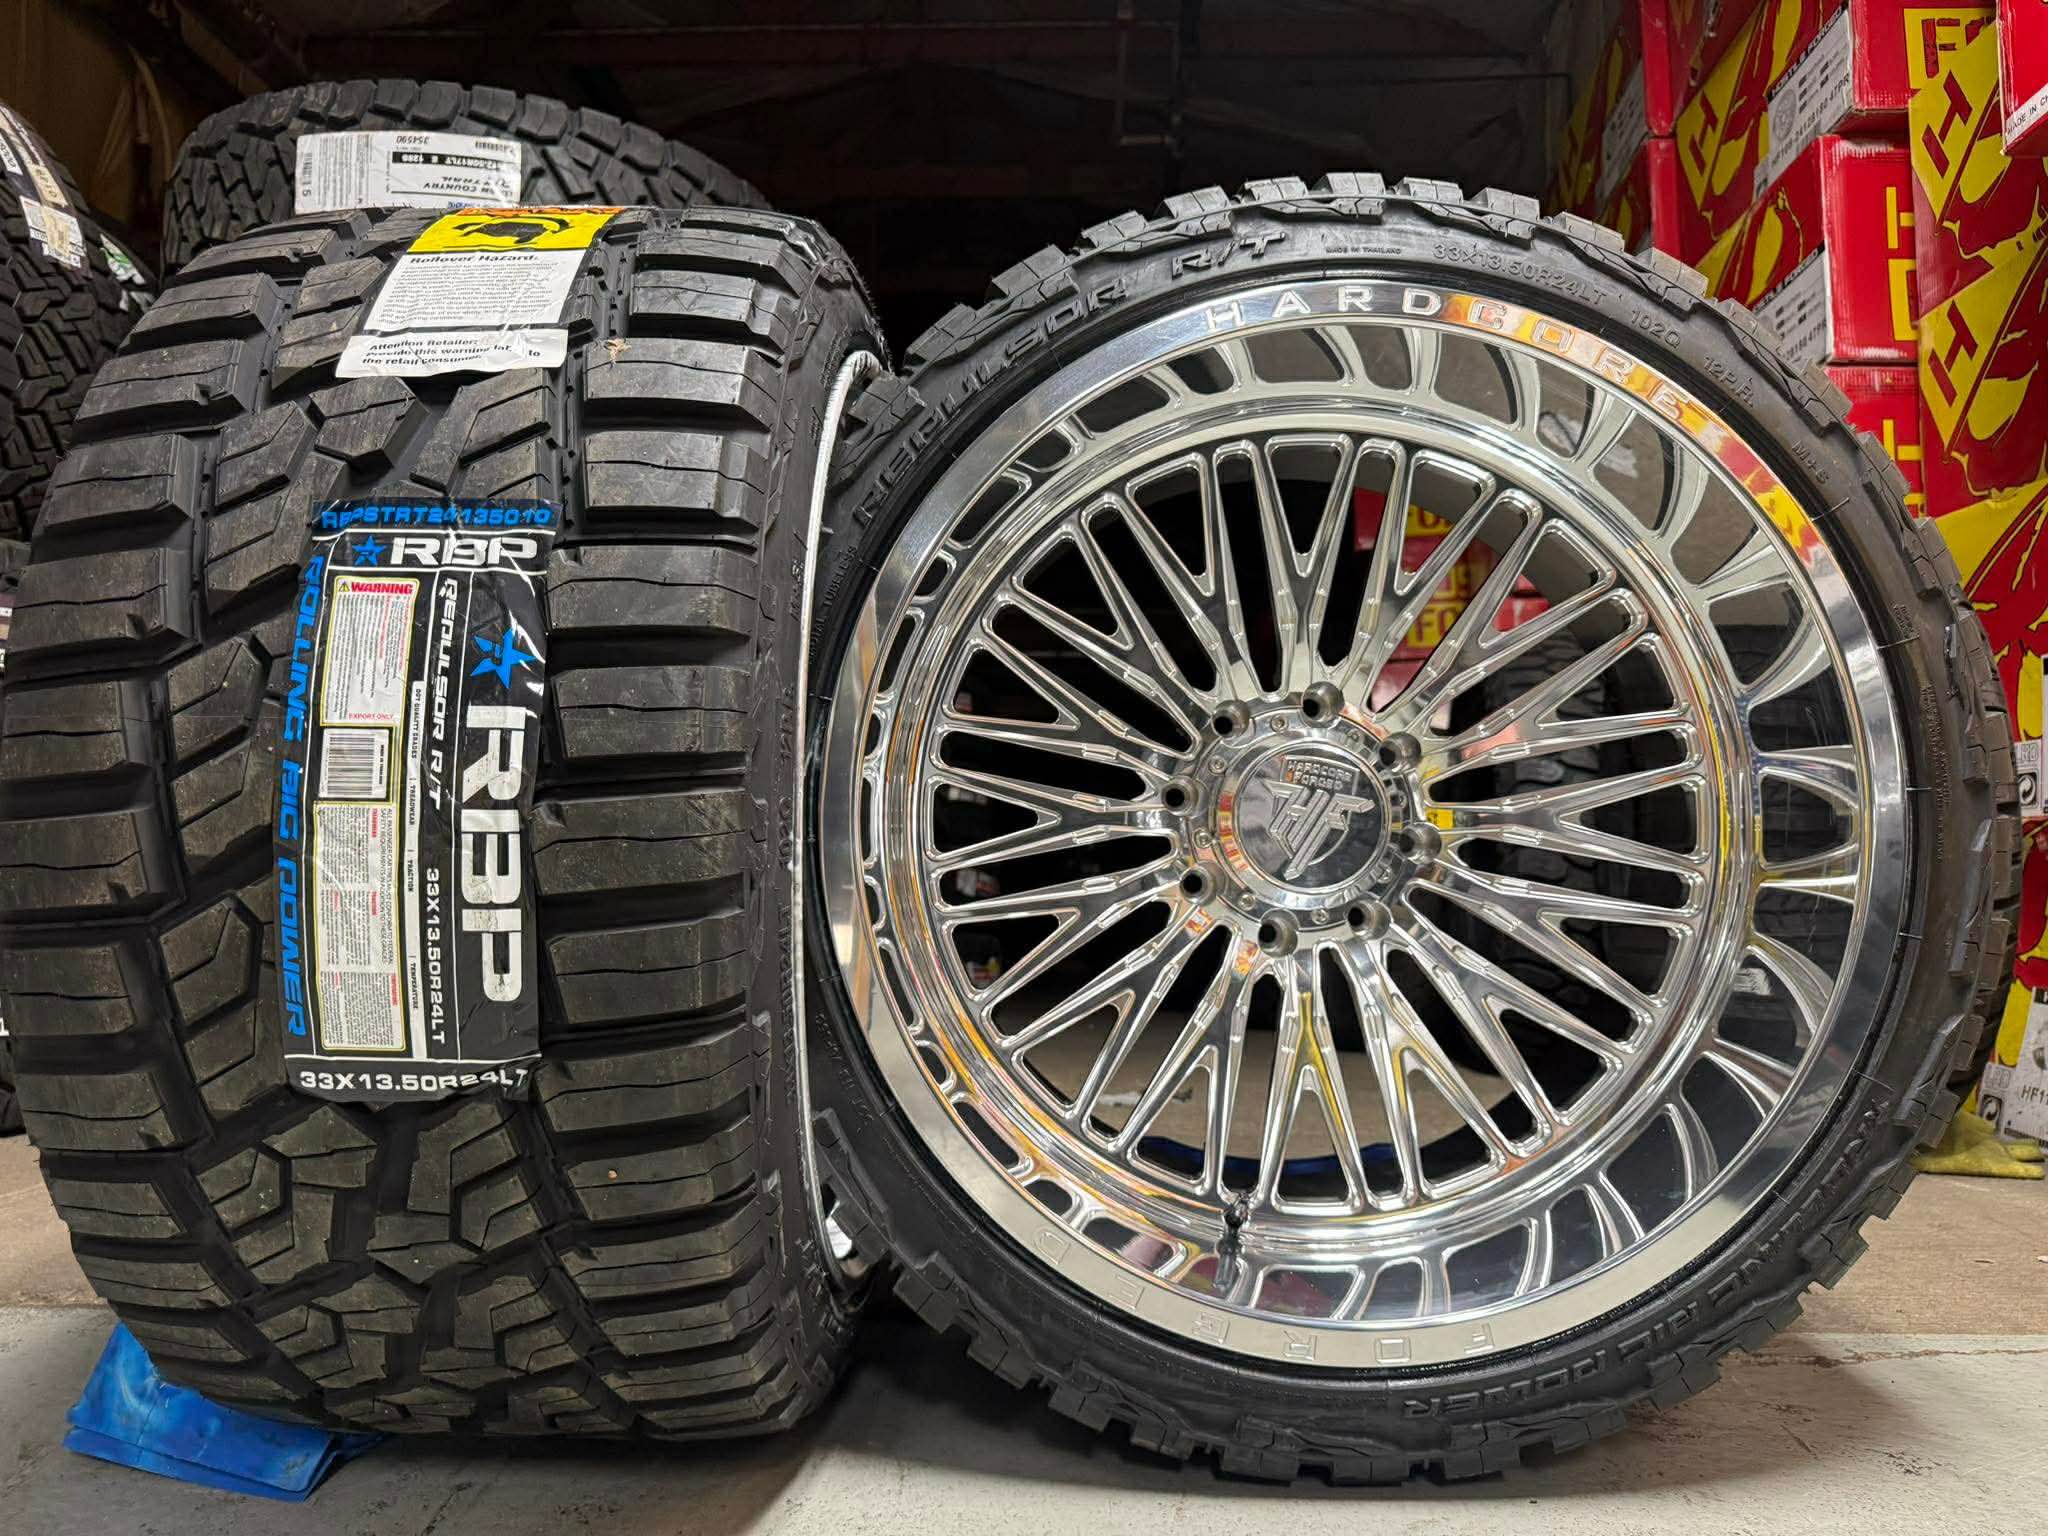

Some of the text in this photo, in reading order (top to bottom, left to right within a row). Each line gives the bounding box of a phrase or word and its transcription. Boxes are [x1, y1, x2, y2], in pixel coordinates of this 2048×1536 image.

[2029, 104, 2037, 115] IN
[423, 182, 478, 193] COUNTRY
[409, 254, 476, 263] Rollover
[369, 339, 423, 351] Attention
[385, 356, 418, 366] retail
[528, 350, 541, 358] to
[852, 276, 1130, 528] REPULSOR
[1171, 230, 1287, 280] R/T
[389, 536, 539, 567] RBP
[350, 580, 414, 596] WARNING
[431, 577, 459, 742] REPULSOR
[413, 703, 421, 735] QUALITY
[277, 555, 326, 1037] ROLLING BIG POWER
[408, 785, 417, 826] TREADWEAR
[459, 704, 527, 1003] RBP
[407, 859, 415, 893] TRACTION
[425, 867, 447, 1045] 33X13.50R24LT
[409, 962, 419, 1009] TEMPERATURE
[299, 1067, 529, 1094] 33X13.50R24LT
[1403, 1349, 1606, 1418] POWER
